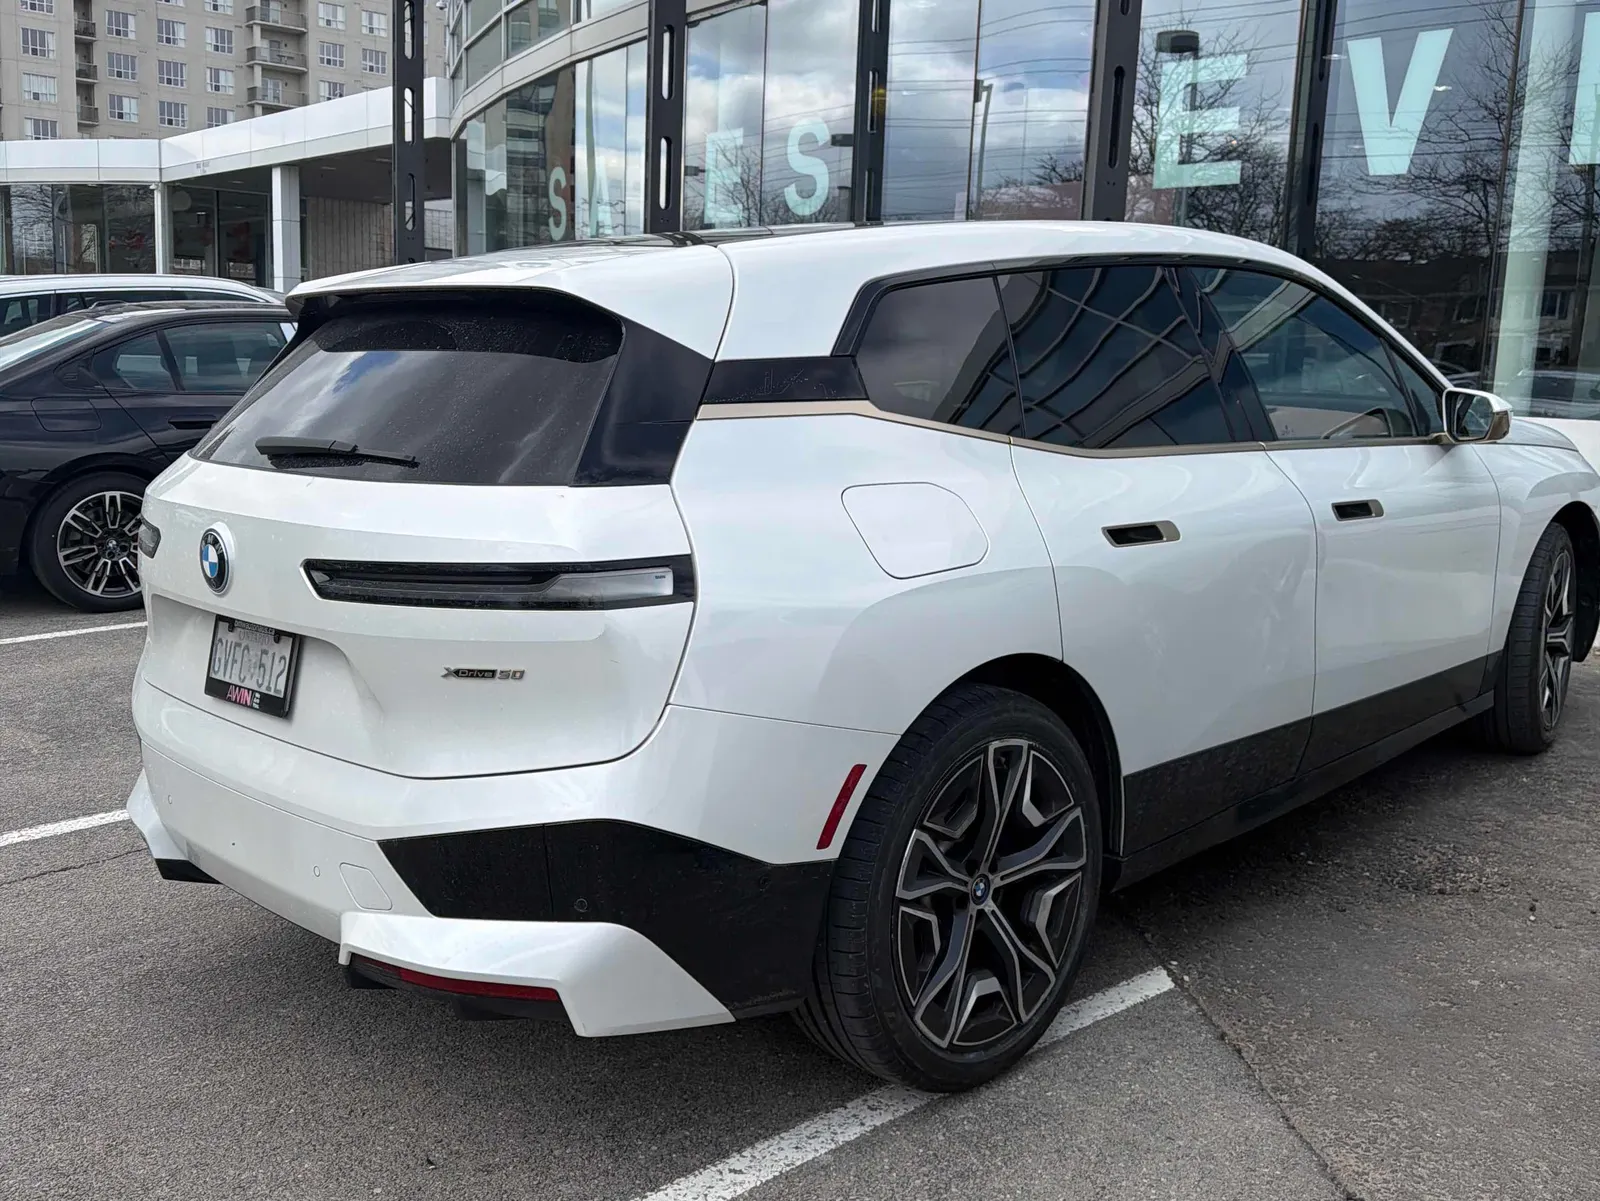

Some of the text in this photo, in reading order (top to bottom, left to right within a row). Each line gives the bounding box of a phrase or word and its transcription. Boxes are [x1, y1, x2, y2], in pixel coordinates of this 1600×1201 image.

[256, 648, 287, 696] 512
[498, 669, 525, 680] 50
[226, 684, 252, 706] AWIN
